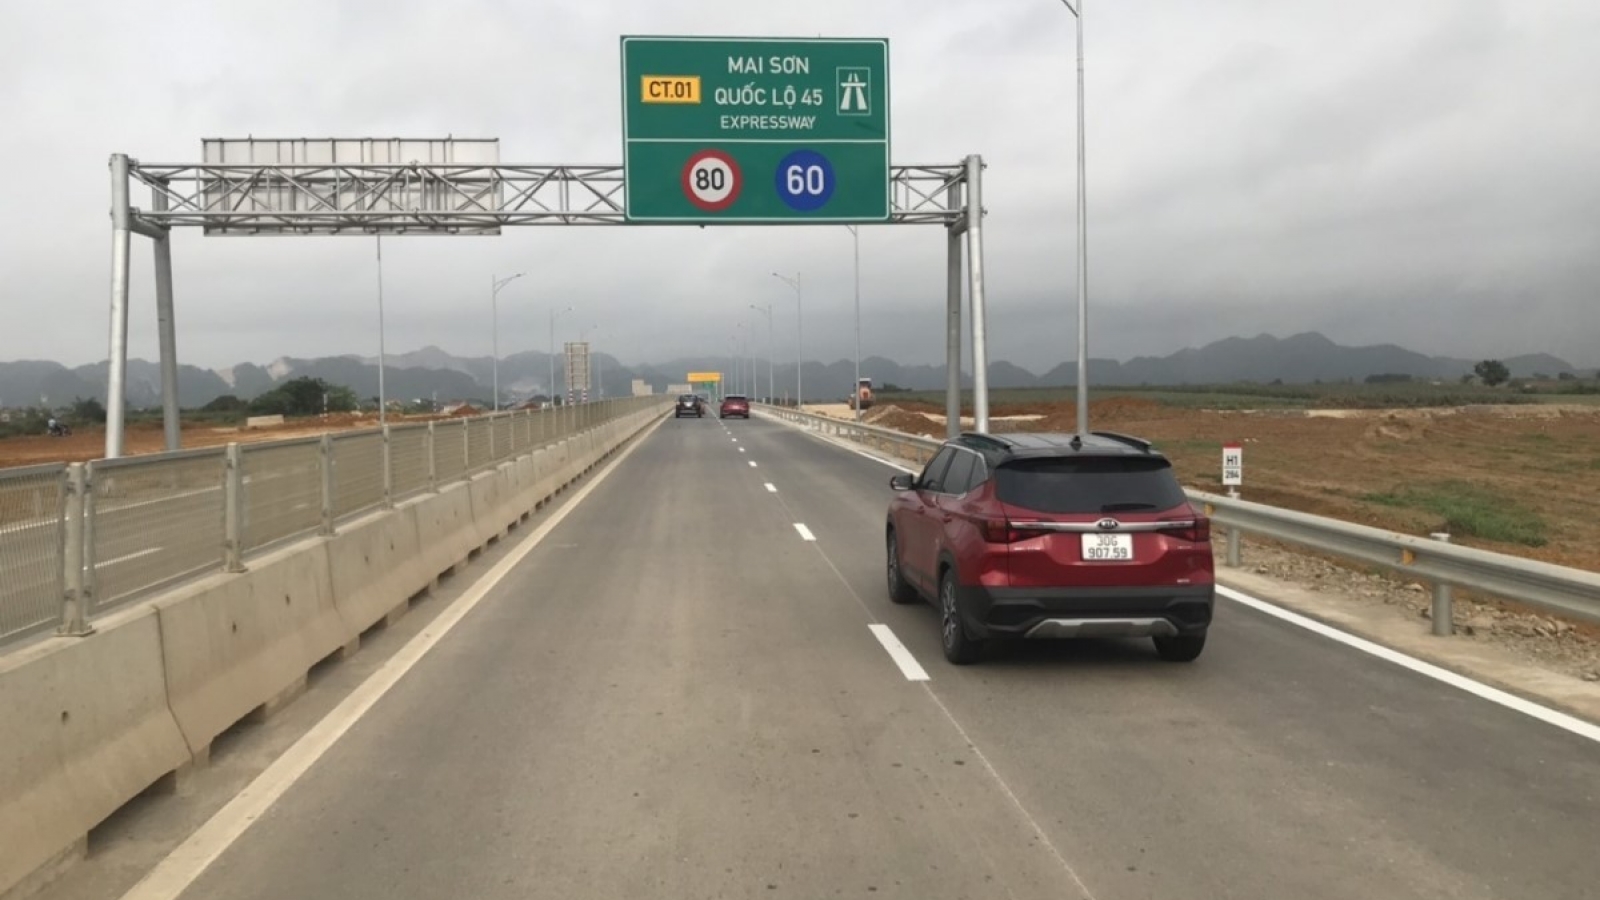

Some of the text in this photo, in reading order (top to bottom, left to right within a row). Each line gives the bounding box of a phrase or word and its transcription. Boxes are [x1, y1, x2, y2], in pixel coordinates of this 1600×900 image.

[728, 55, 809, 73] MAI SƠN
[650, 81, 692, 98] CT.01
[715, 82, 823, 109] QUỐC LỘ 45
[721, 115, 816, 130] EXPRESSWAY
[695, 165, 824, 195] 80 60
[1227, 455, 1238, 465] H1
[1097, 535, 1118, 546] 30G
[1088, 547, 1128, 558] 907.59
